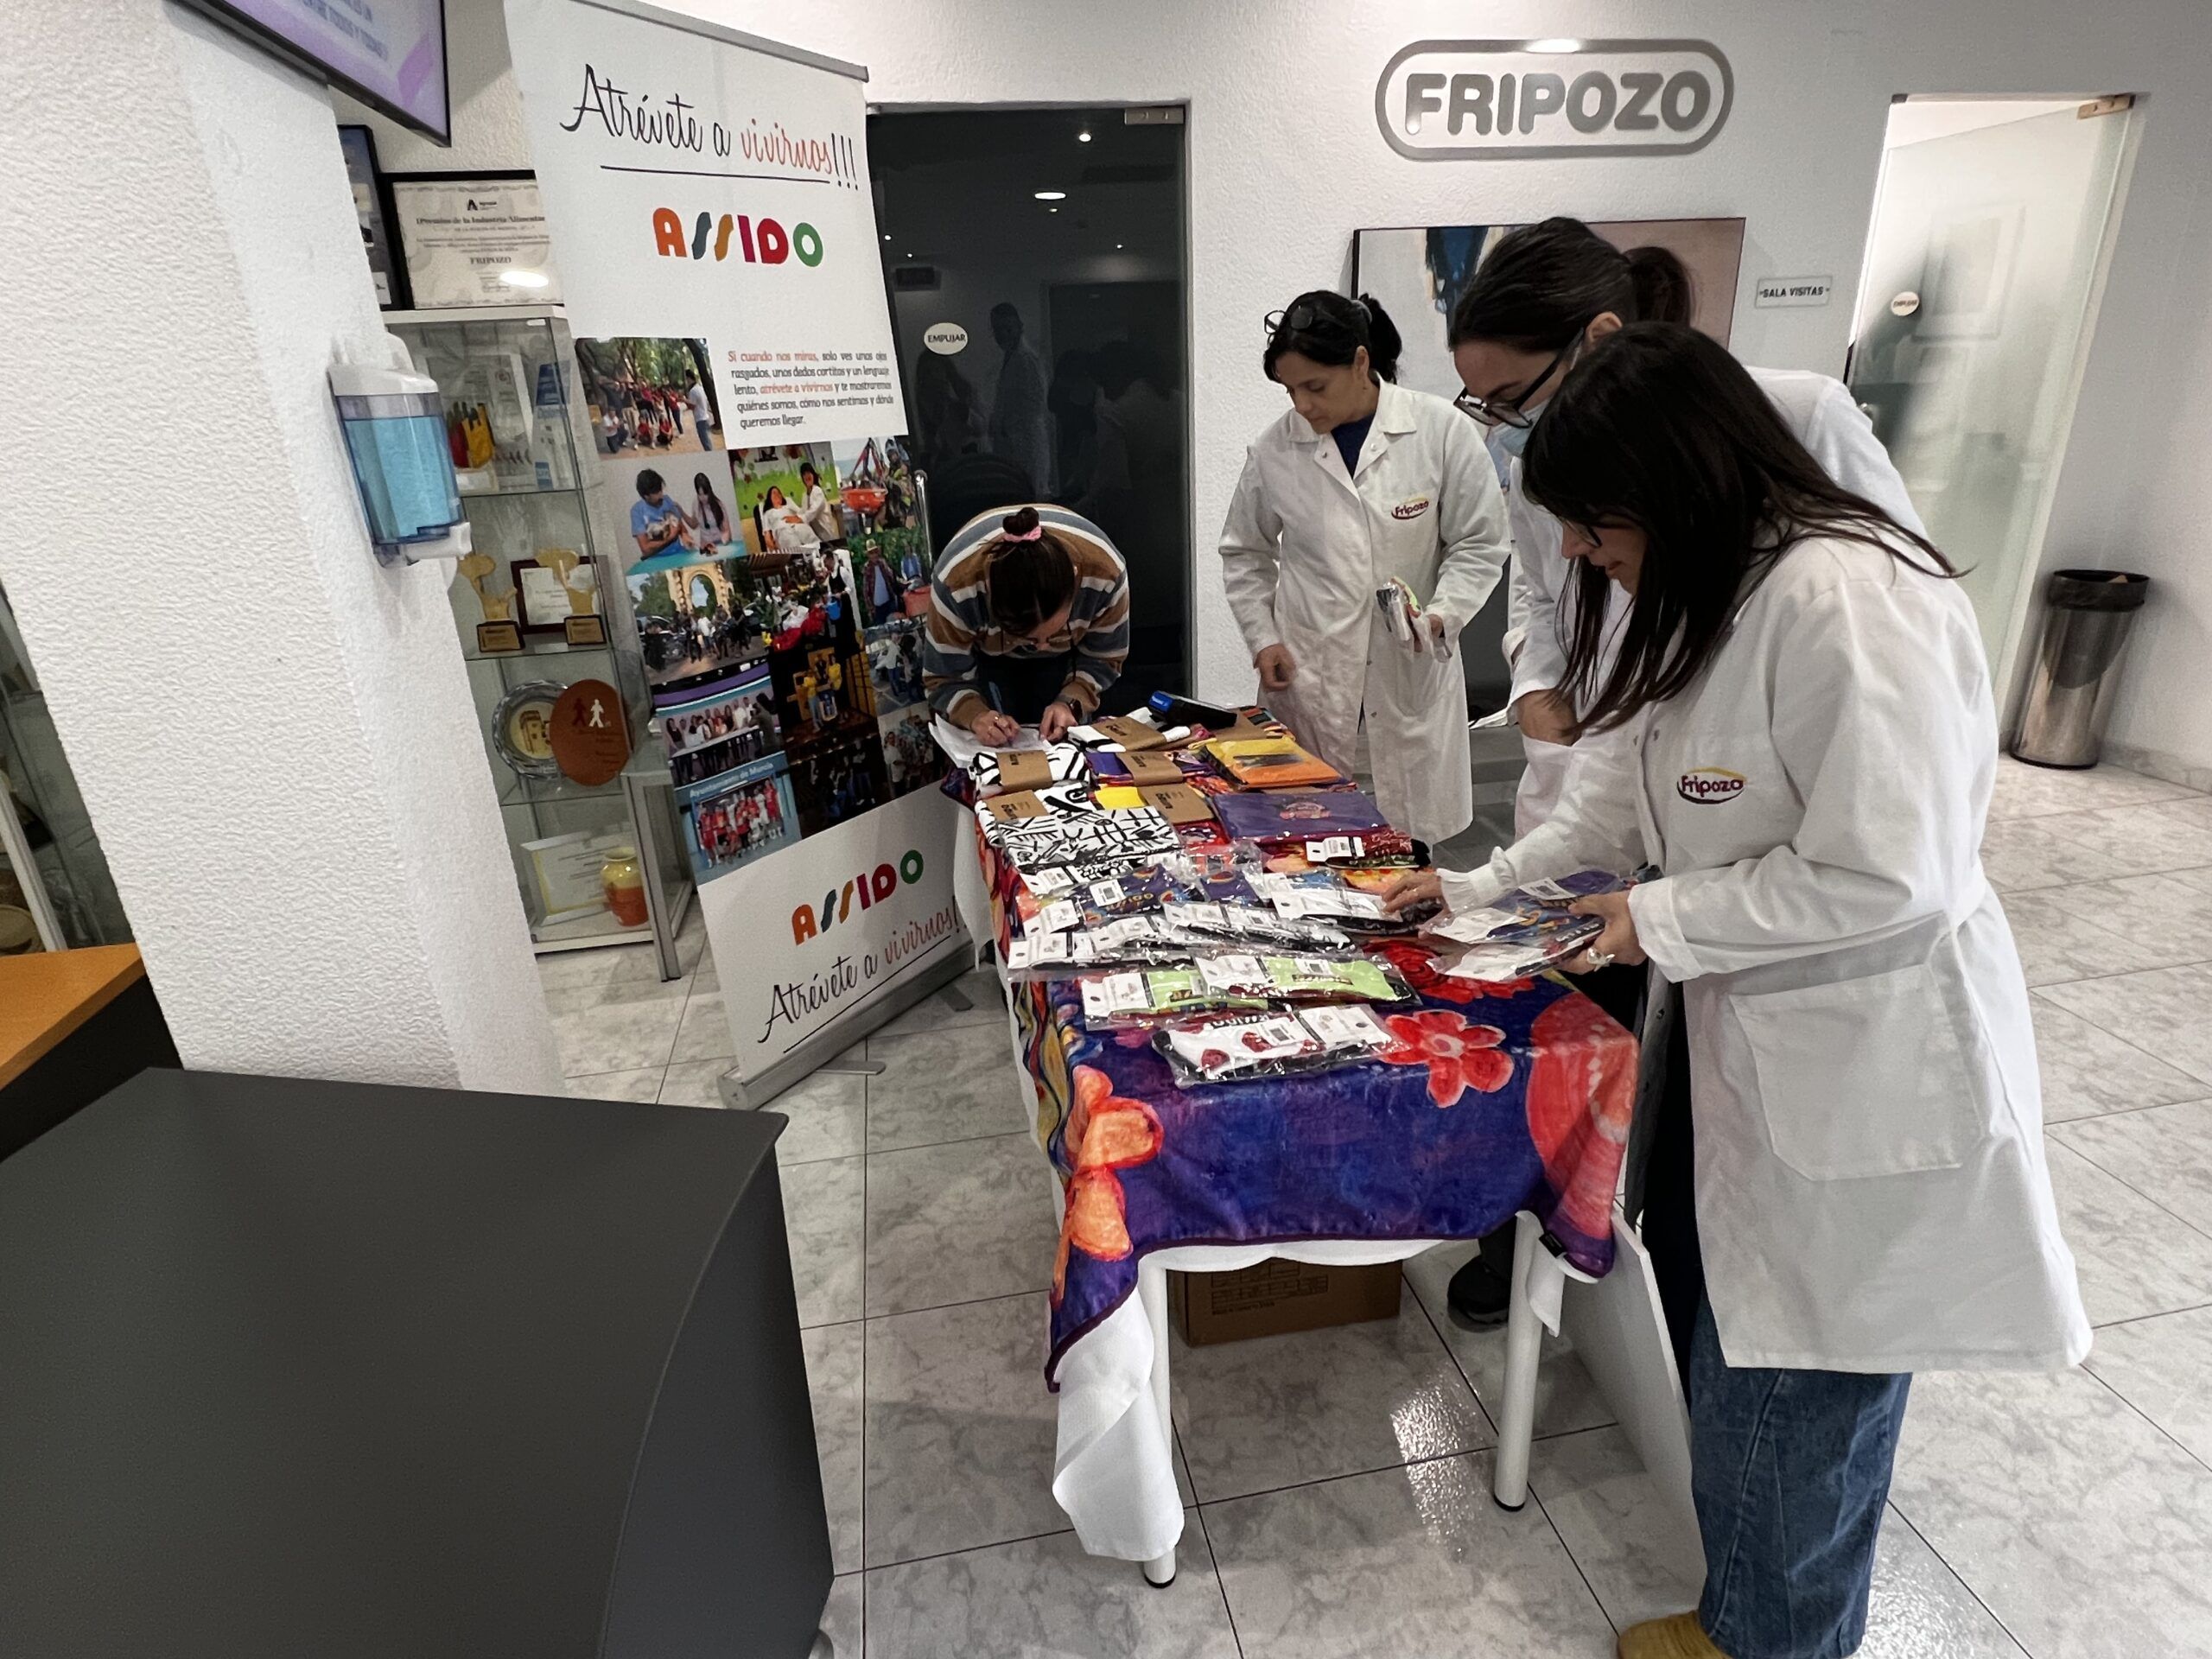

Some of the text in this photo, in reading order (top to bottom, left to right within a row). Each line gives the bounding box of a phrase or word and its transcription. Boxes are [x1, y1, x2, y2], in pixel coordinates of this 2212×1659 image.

[560, 63, 702, 153] Atrévete
[713, 122, 731, 157] a
[1405, 70, 1711, 136] FRIPOZO
[652, 207, 823, 268] ASSIDO
[1763, 286, 1824, 298] SALA VISITAS
[927, 334, 967, 343] EMPUJAR
[728, 350, 887, 363] Si cuando nos miras, solo ves unos ojos
[731, 366, 772, 381] rasgados,
[772, 369, 792, 378] unos
[793, 366, 816, 378] dedos
[817, 366, 845, 378] cortitos
[846, 368, 852, 378] y
[852, 367, 862, 377] un
[734, 384, 759, 396] lento,
[760, 383, 792, 395] atrévete
[800, 381, 834, 393] vivirnos
[834, 383, 841, 393] y
[841, 382, 849, 391] te
[849, 380, 893, 391] mostraremos
[737, 399, 770, 415] quiénes
[771, 401, 798, 410] somos,
[799, 398, 822, 409] cómo
[822, 398, 836, 408] nos
[836, 395, 869, 406] sentimos
[869, 397, 875, 407] y
[740, 414, 805, 430] queremos llegar.
[791, 849, 924, 945] ASSIDO
[758, 895, 967, 1043] Atrévete a vivirnos!
